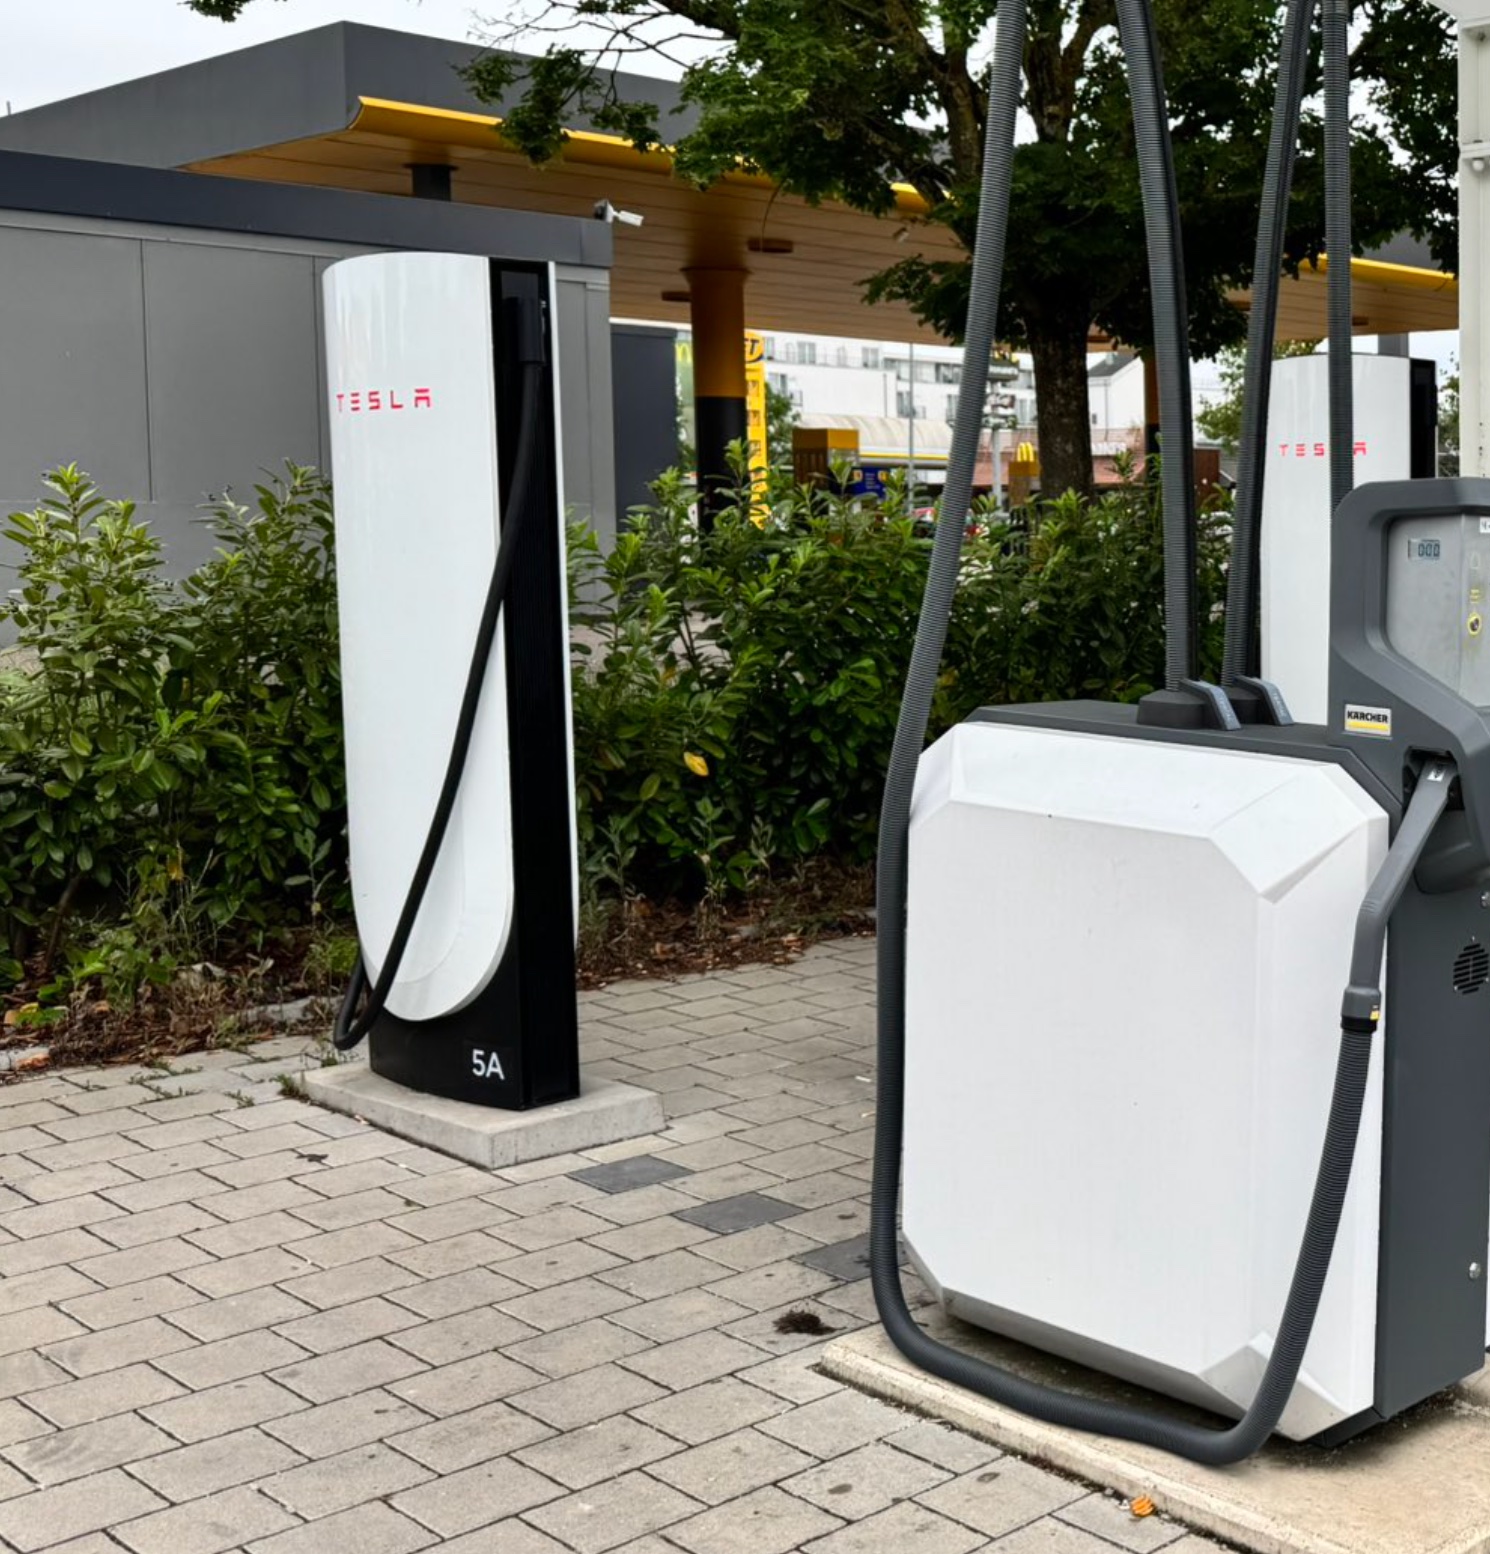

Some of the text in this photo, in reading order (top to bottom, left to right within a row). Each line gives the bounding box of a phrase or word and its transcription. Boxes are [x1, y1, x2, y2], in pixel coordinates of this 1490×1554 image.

[336, 388, 430, 412] TESLA
[1279, 442, 1366, 457] TESA
[472, 1048, 505, 1080] 5A
